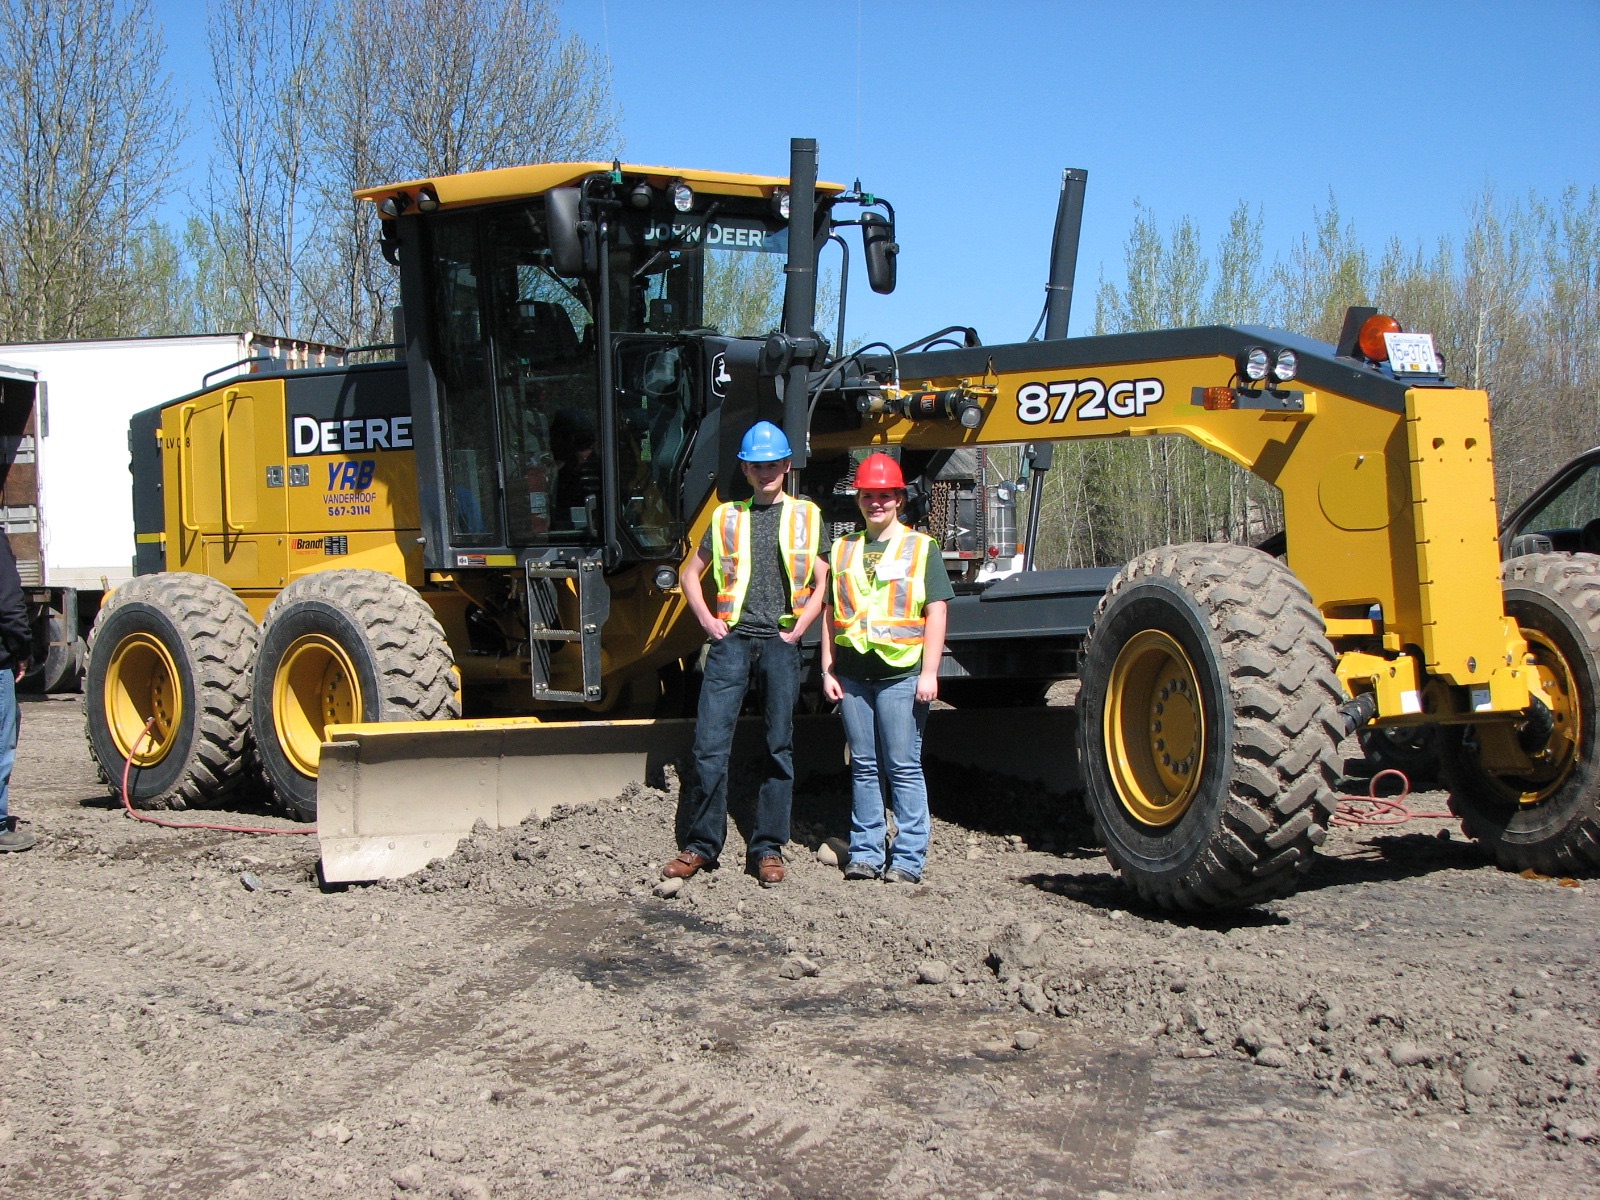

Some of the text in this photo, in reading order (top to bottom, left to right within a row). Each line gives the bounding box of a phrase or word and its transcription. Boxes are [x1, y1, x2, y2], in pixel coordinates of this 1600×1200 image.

[1017, 378, 1164, 424] 872GP
[293, 415, 413, 454] DEERE
[327, 460, 376, 491] YRB
[323, 492, 377, 505] VANDERHOOF
[328, 505, 371, 517] 567-3114
[296, 538, 323, 549] Brandt
